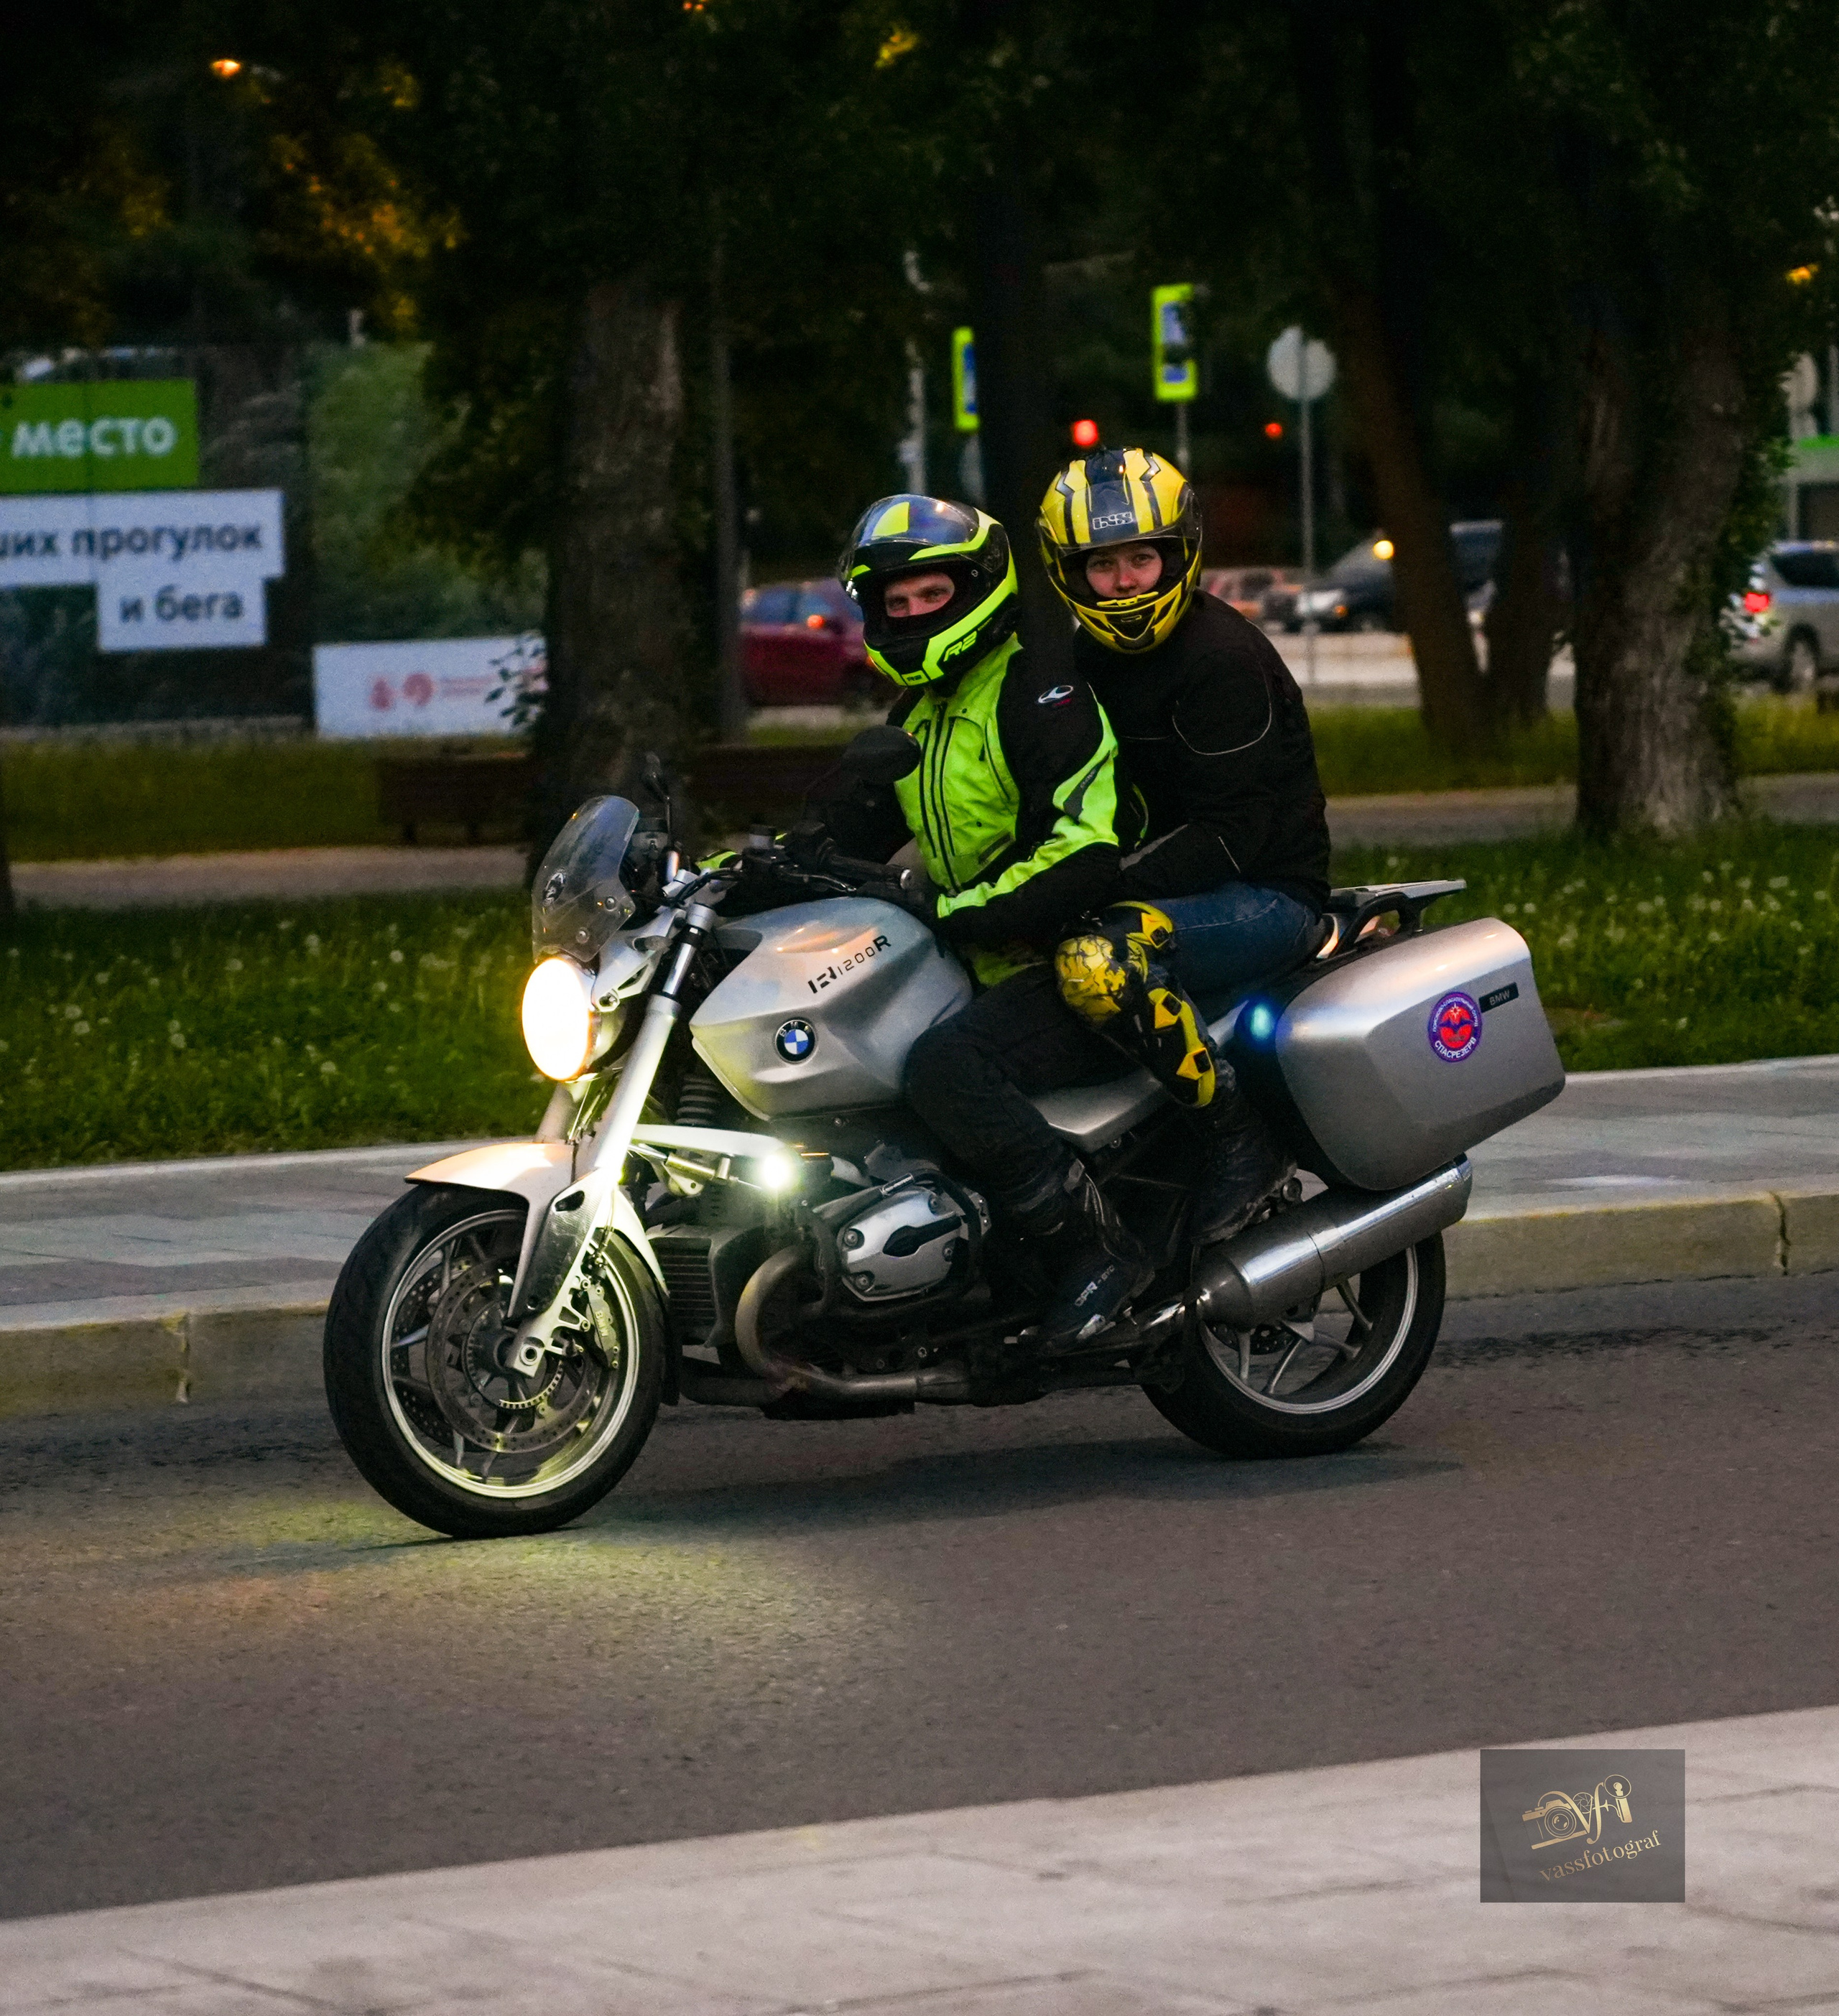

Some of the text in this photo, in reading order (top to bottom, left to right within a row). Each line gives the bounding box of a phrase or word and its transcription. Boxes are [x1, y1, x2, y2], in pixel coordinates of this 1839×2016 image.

[11, 415, 177, 457] место
[73, 522, 262, 562] прогулок
[120, 584, 244, 623] и бега
[943, 631, 977, 661] R2
[1489, 990, 1510, 1005] BMW
[1435, 1036, 1477, 1059] СПАСРЕЗЕРВ
